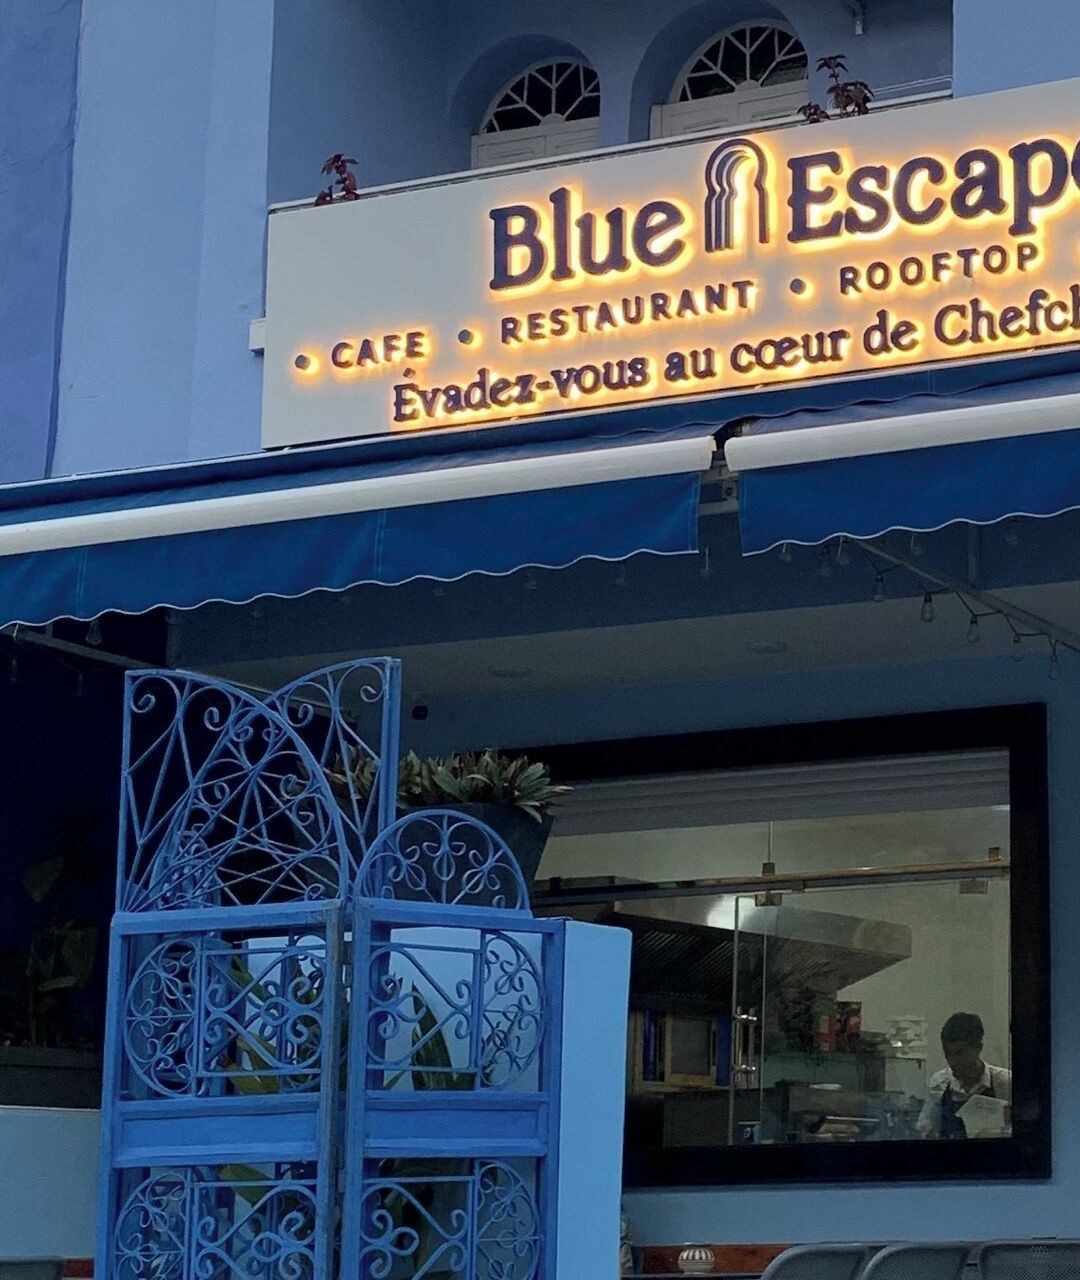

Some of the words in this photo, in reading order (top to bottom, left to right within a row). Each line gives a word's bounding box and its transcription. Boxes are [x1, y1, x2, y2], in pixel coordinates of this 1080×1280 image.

[489, 187, 685, 290] Blue
[501, 280, 756, 344] RESTAURANT
[839, 242, 1039, 296] ROOFTOP
[393, 354, 649, 423] Évadez-vous
[664, 346, 716, 382] au
[730, 324, 851, 373] cœur
[862, 310, 919, 355] de
